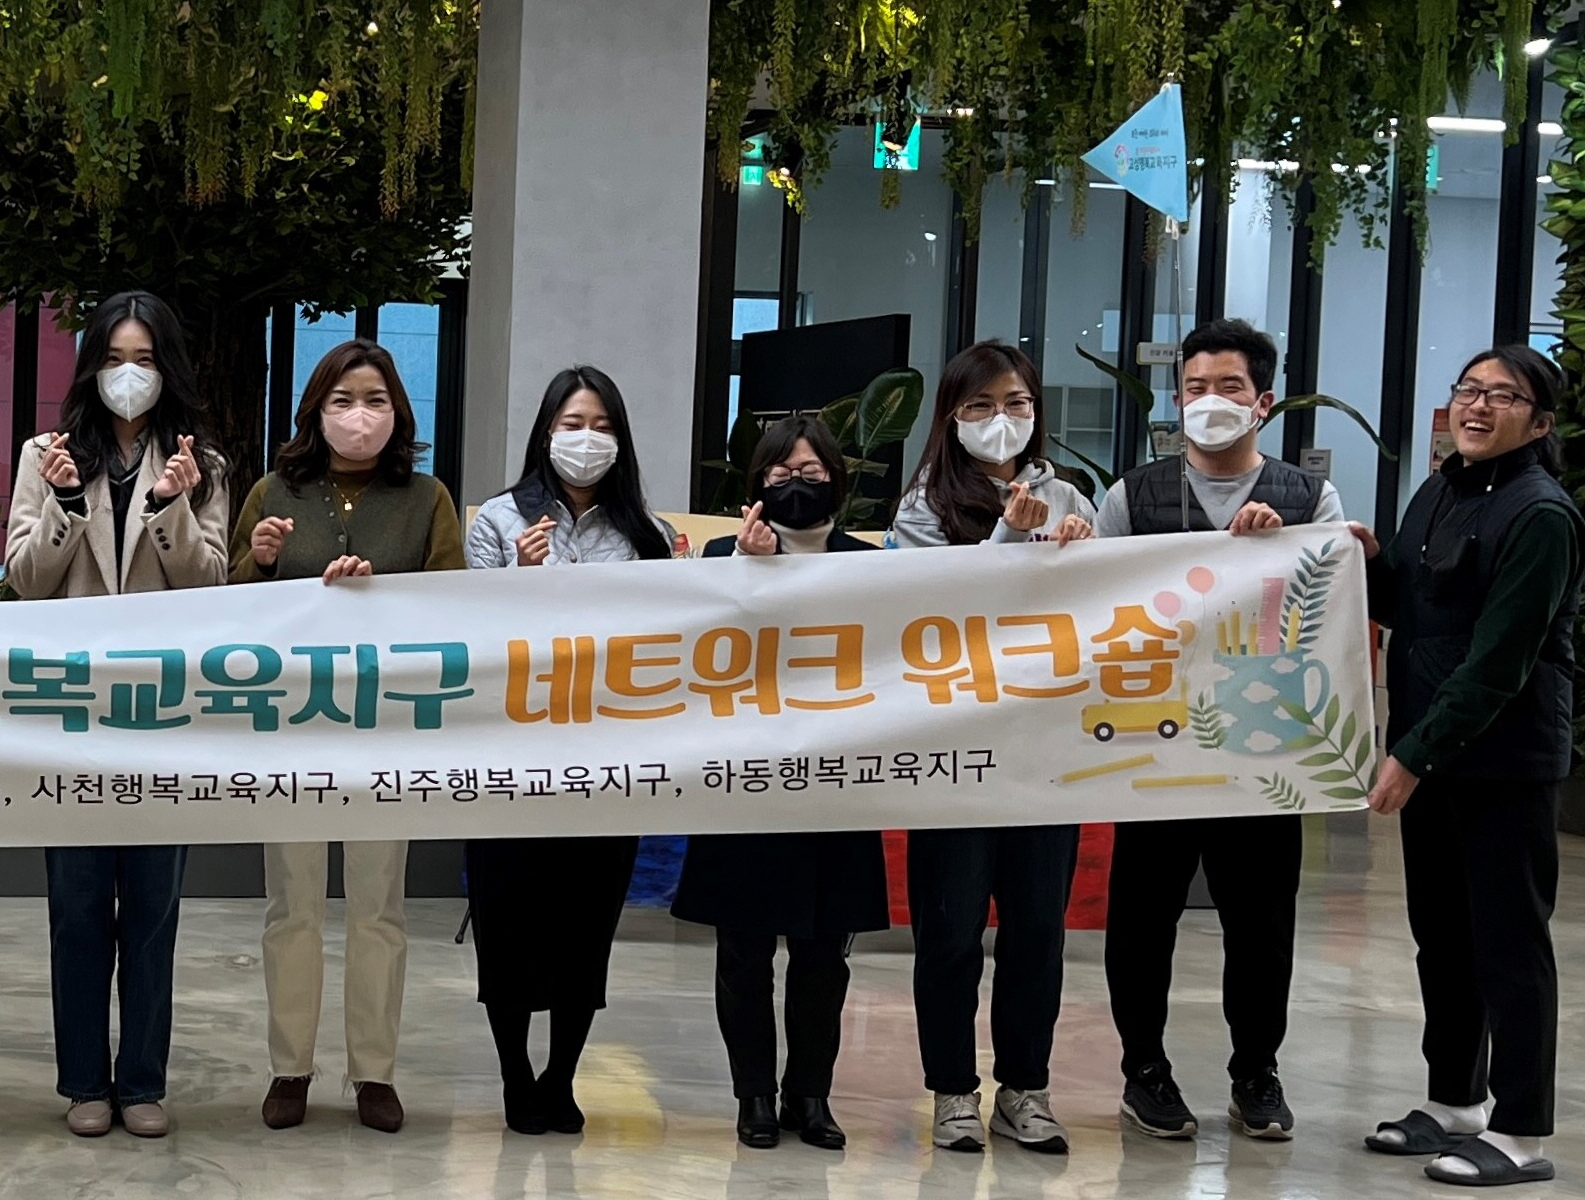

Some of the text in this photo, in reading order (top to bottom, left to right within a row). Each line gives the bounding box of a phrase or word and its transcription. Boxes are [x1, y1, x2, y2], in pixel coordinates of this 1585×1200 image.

[504, 625, 877, 724] 네트워크
[902, 604, 1181, 705] 워크숍
[30, 771, 351, 807] 사천행복교육지구,
[369, 761, 683, 804] 진주행복교육지구,
[701, 747, 998, 796] 하동행복교육지구
